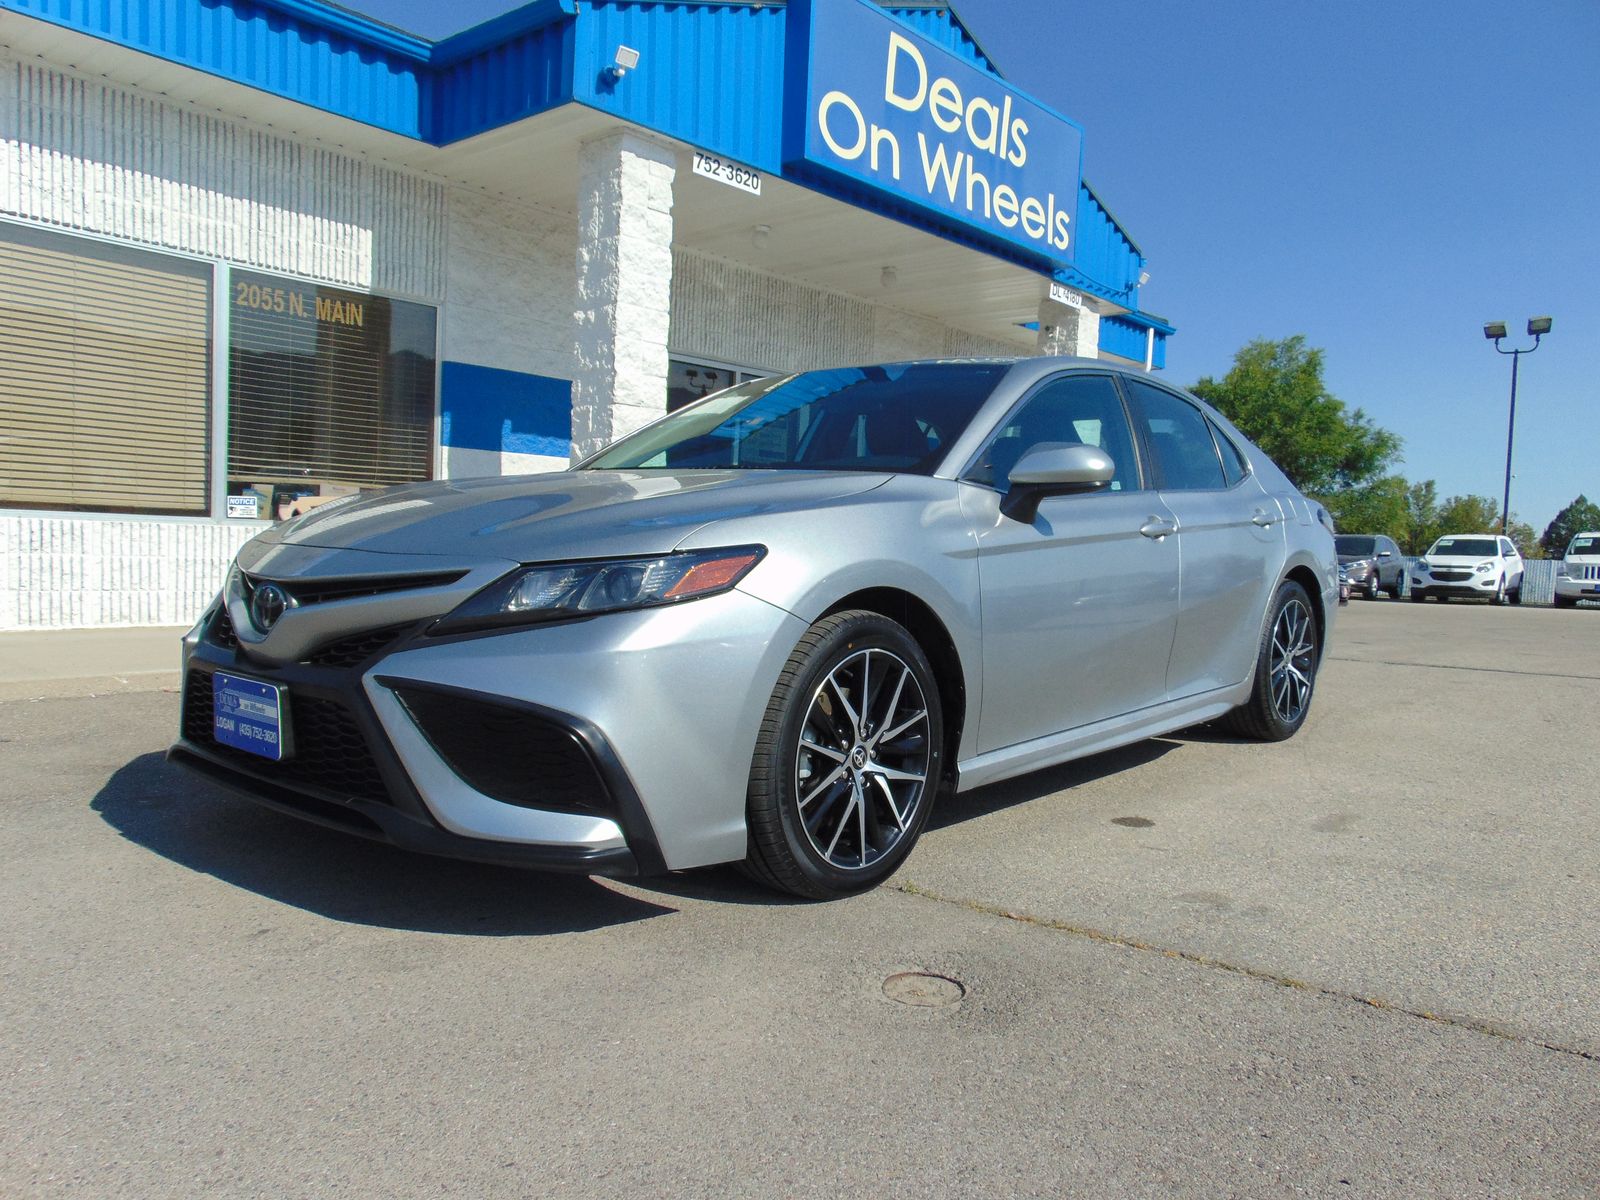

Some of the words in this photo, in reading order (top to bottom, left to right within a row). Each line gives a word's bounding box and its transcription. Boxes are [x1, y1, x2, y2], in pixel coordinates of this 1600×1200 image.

[885, 31, 1029, 168] Deals
[695, 152, 759, 190] 752-3620
[818, 90, 900, 181] On
[918, 131, 1070, 250] Wheels
[236, 282, 284, 313] 2055
[289, 291, 308, 318] N.
[315, 296, 364, 327] MAIN
[216, 715, 235, 731] LOGAN
